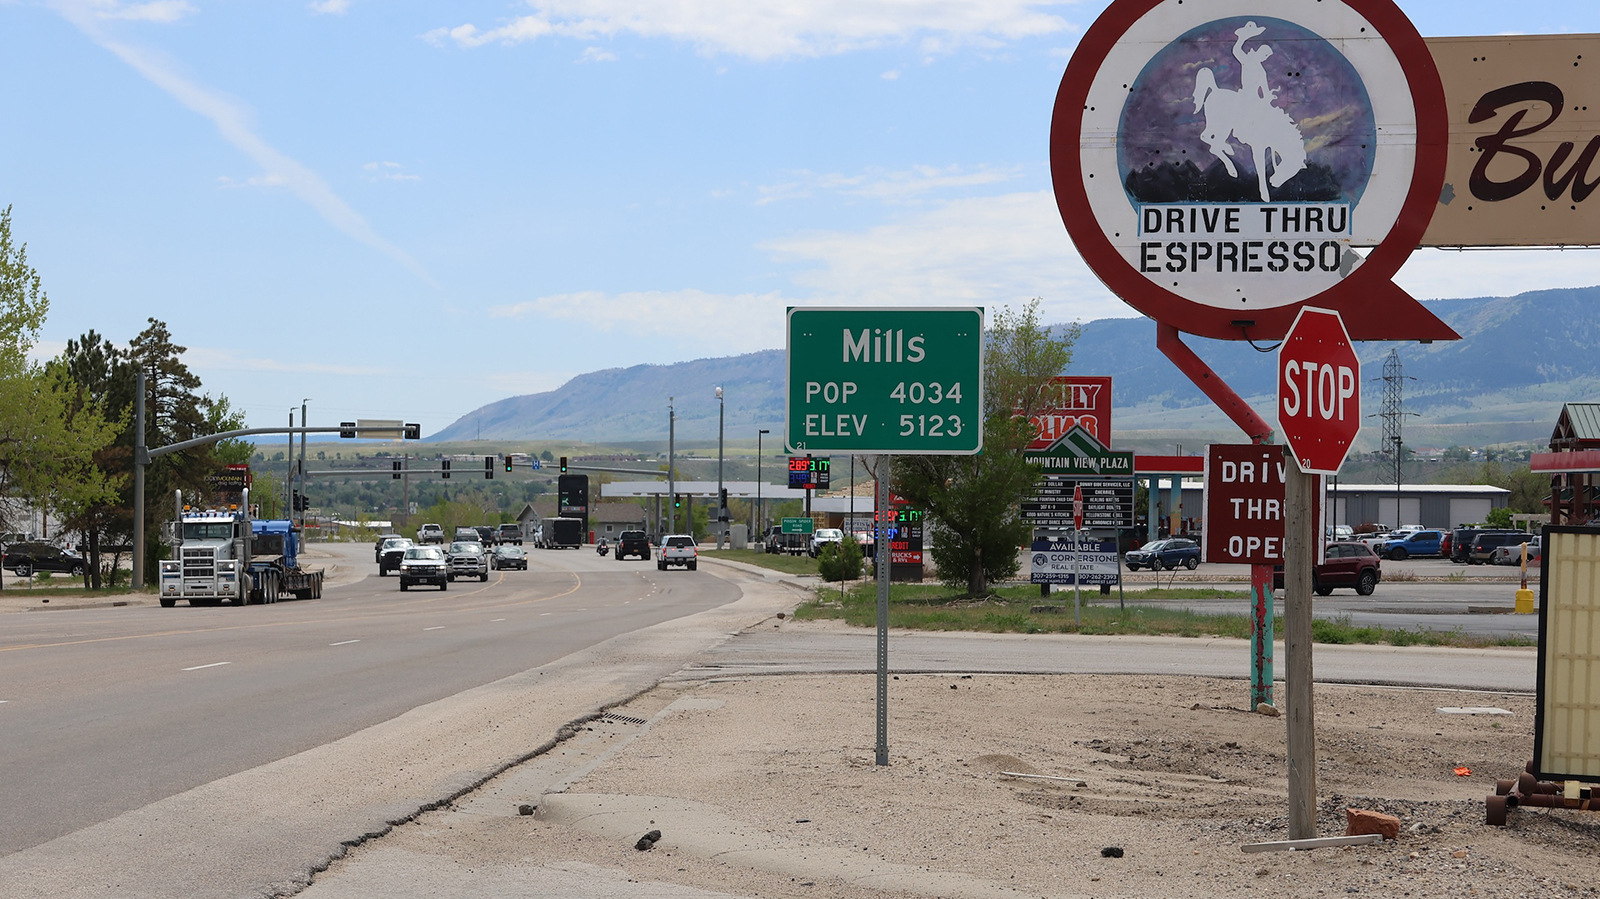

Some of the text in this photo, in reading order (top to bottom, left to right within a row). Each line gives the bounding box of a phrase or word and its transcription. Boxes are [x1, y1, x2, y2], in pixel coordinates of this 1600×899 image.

[1143, 207, 1346, 233] DRIVE THRU
[1140, 241, 1341, 272] ESPRESSO
[842, 328, 926, 363] Mills
[806, 382, 963, 404] POP 4034
[1283, 359, 1355, 421] STOP
[805, 414, 962, 437] ELEV 5123
[1010, 414, 1098, 441] OLLAR
[796, 442, 806, 450] 21
[1025, 457, 1129, 469] MOUNTAIN VIEW PLAZA
[1221, 453, 1286, 483] DRiV
[1302, 459, 1311, 469] 20
[1230, 498, 1286, 521] THR
[1049, 543, 1100, 552] AVAILABLE
[1051, 554, 1118, 563] CORNERSTONE
[1228, 536, 1286, 559] OPE
